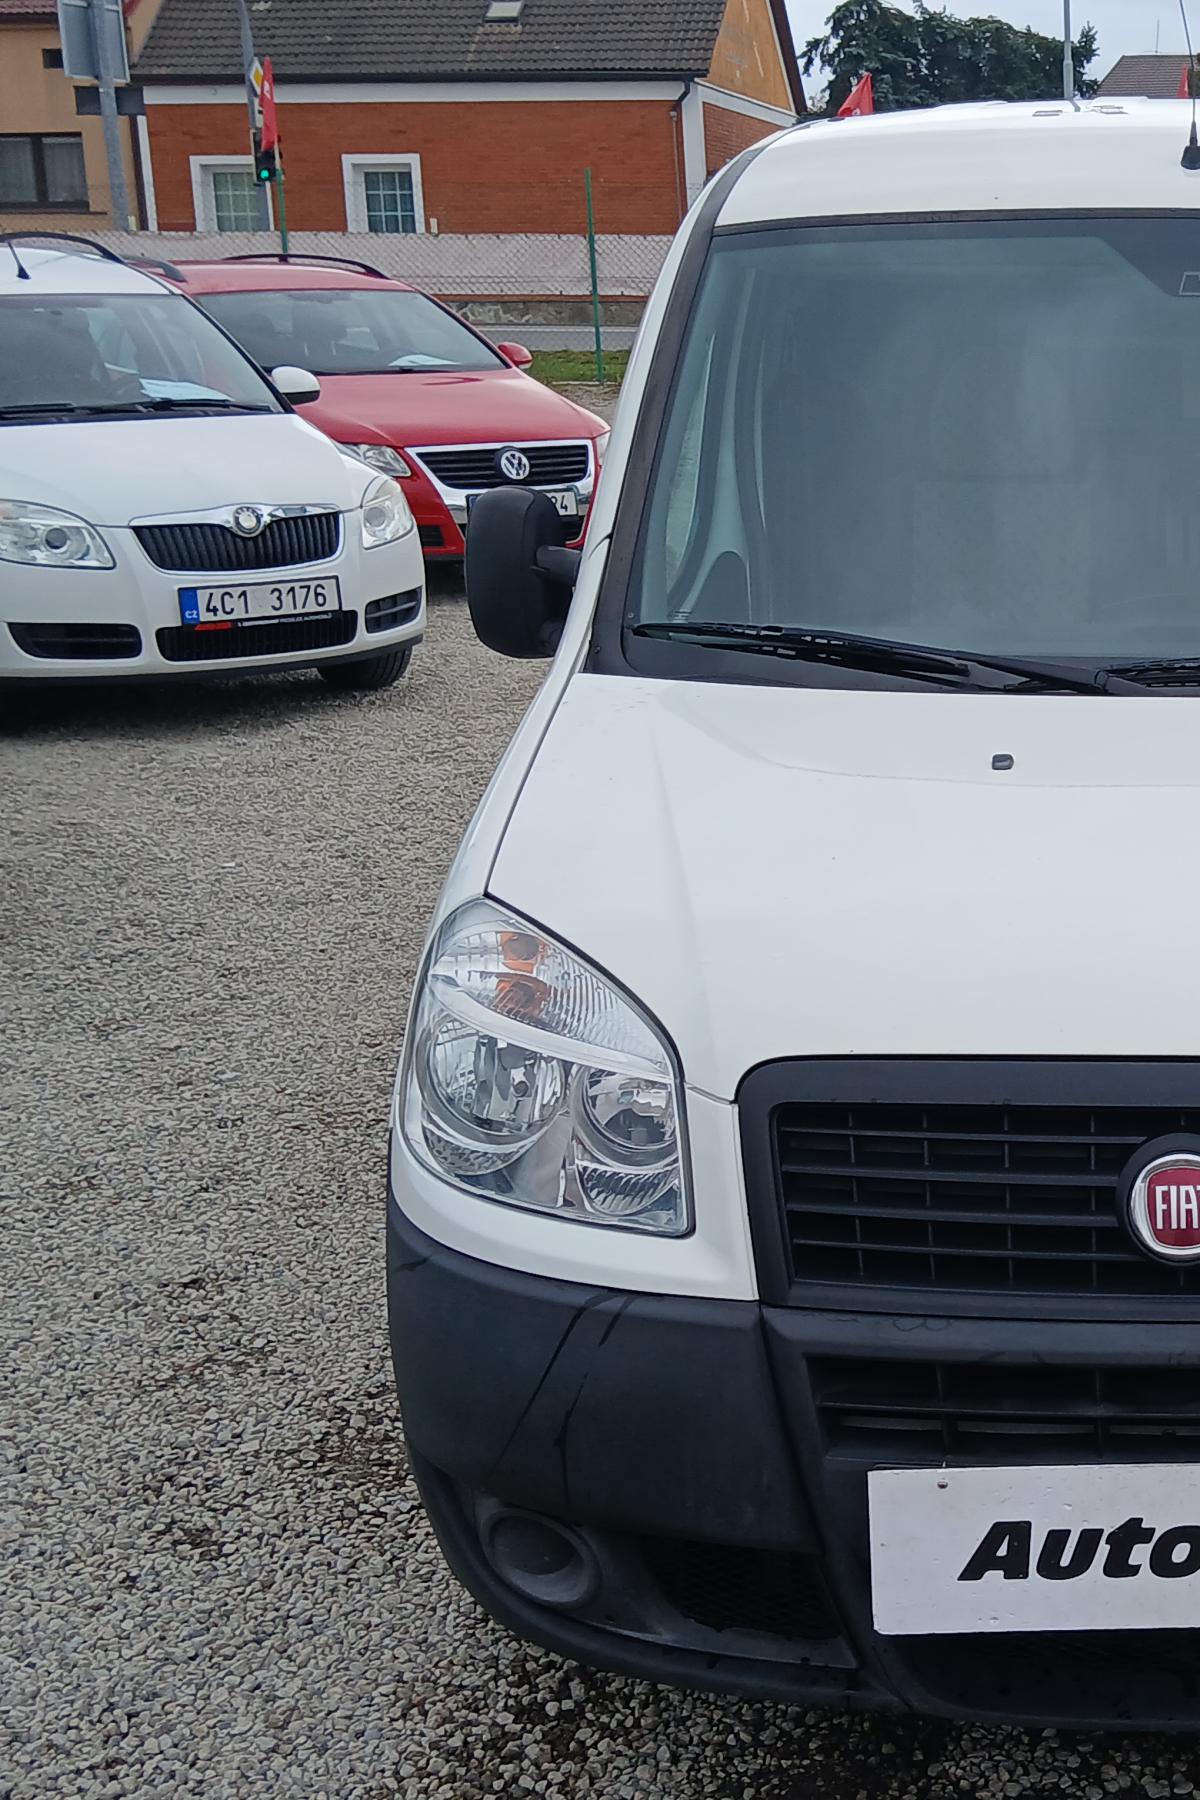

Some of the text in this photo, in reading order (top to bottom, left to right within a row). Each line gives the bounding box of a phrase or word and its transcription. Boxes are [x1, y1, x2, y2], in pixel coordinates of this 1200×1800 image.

[205, 583, 327, 617] 4C1 3176
[184, 609, 198, 619] CZ
